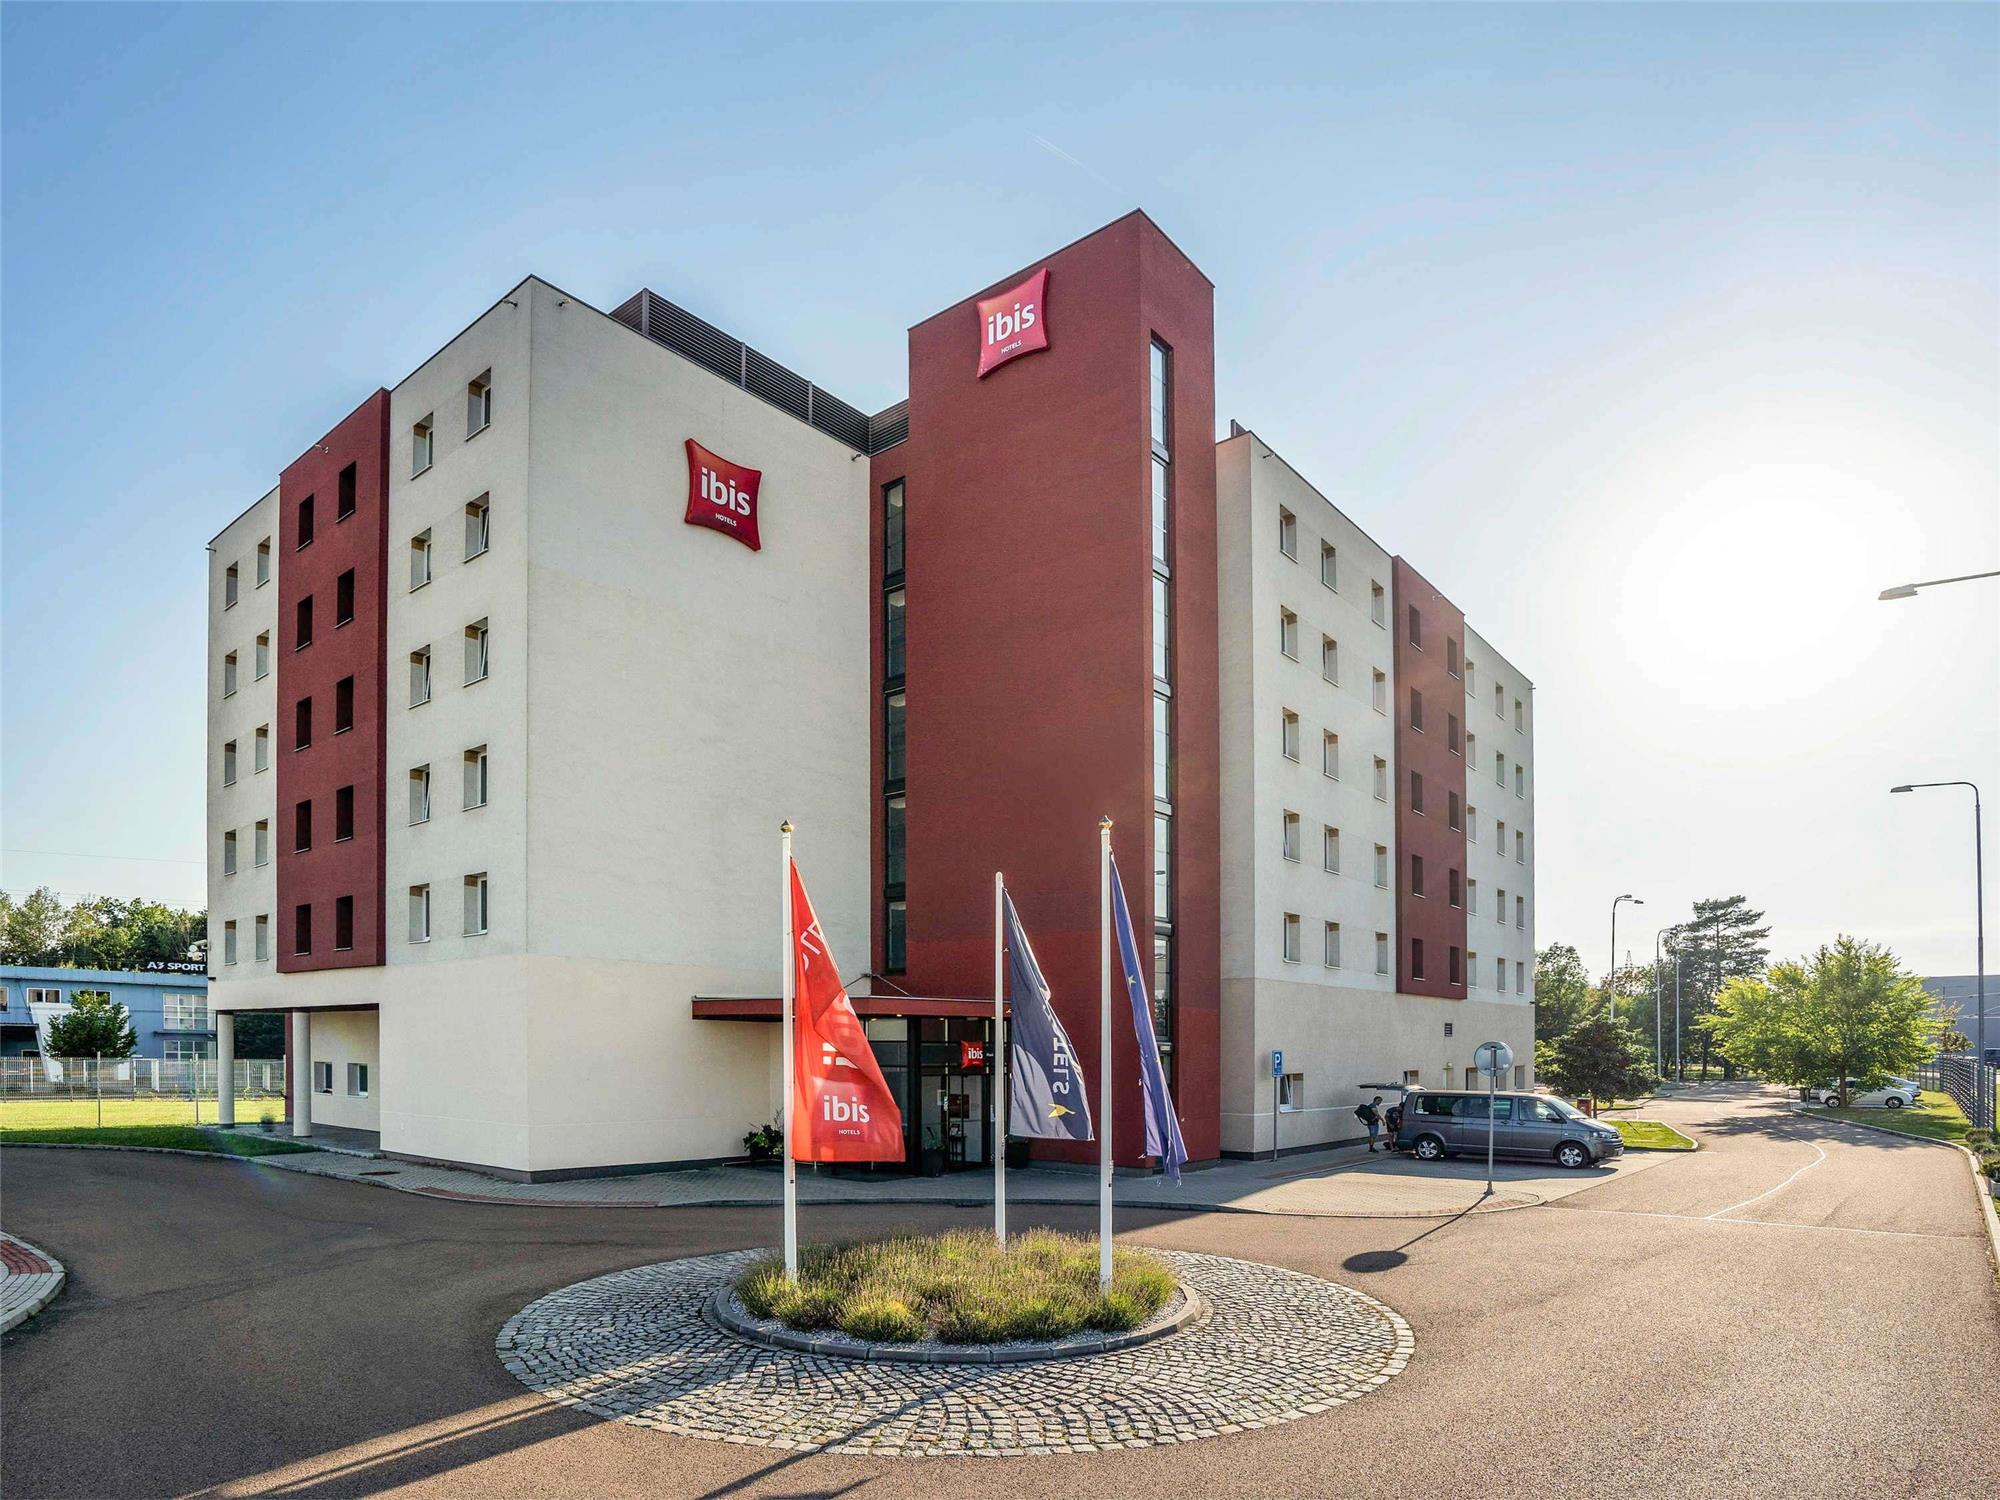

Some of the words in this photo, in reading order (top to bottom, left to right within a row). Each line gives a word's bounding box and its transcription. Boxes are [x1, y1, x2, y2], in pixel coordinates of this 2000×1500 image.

[987, 302, 1035, 346] ibis
[1000, 339, 1022, 355] HOTELS
[701, 466, 751, 516] ibis
[715, 512, 737, 527] HOTELS
[146, 961, 165, 970] A3
[167, 962, 206, 971] SPORT
[967, 1047, 983, 1060] ibis
[1274, 1053, 1281, 1069] P
[823, 1095, 870, 1123] ibis
